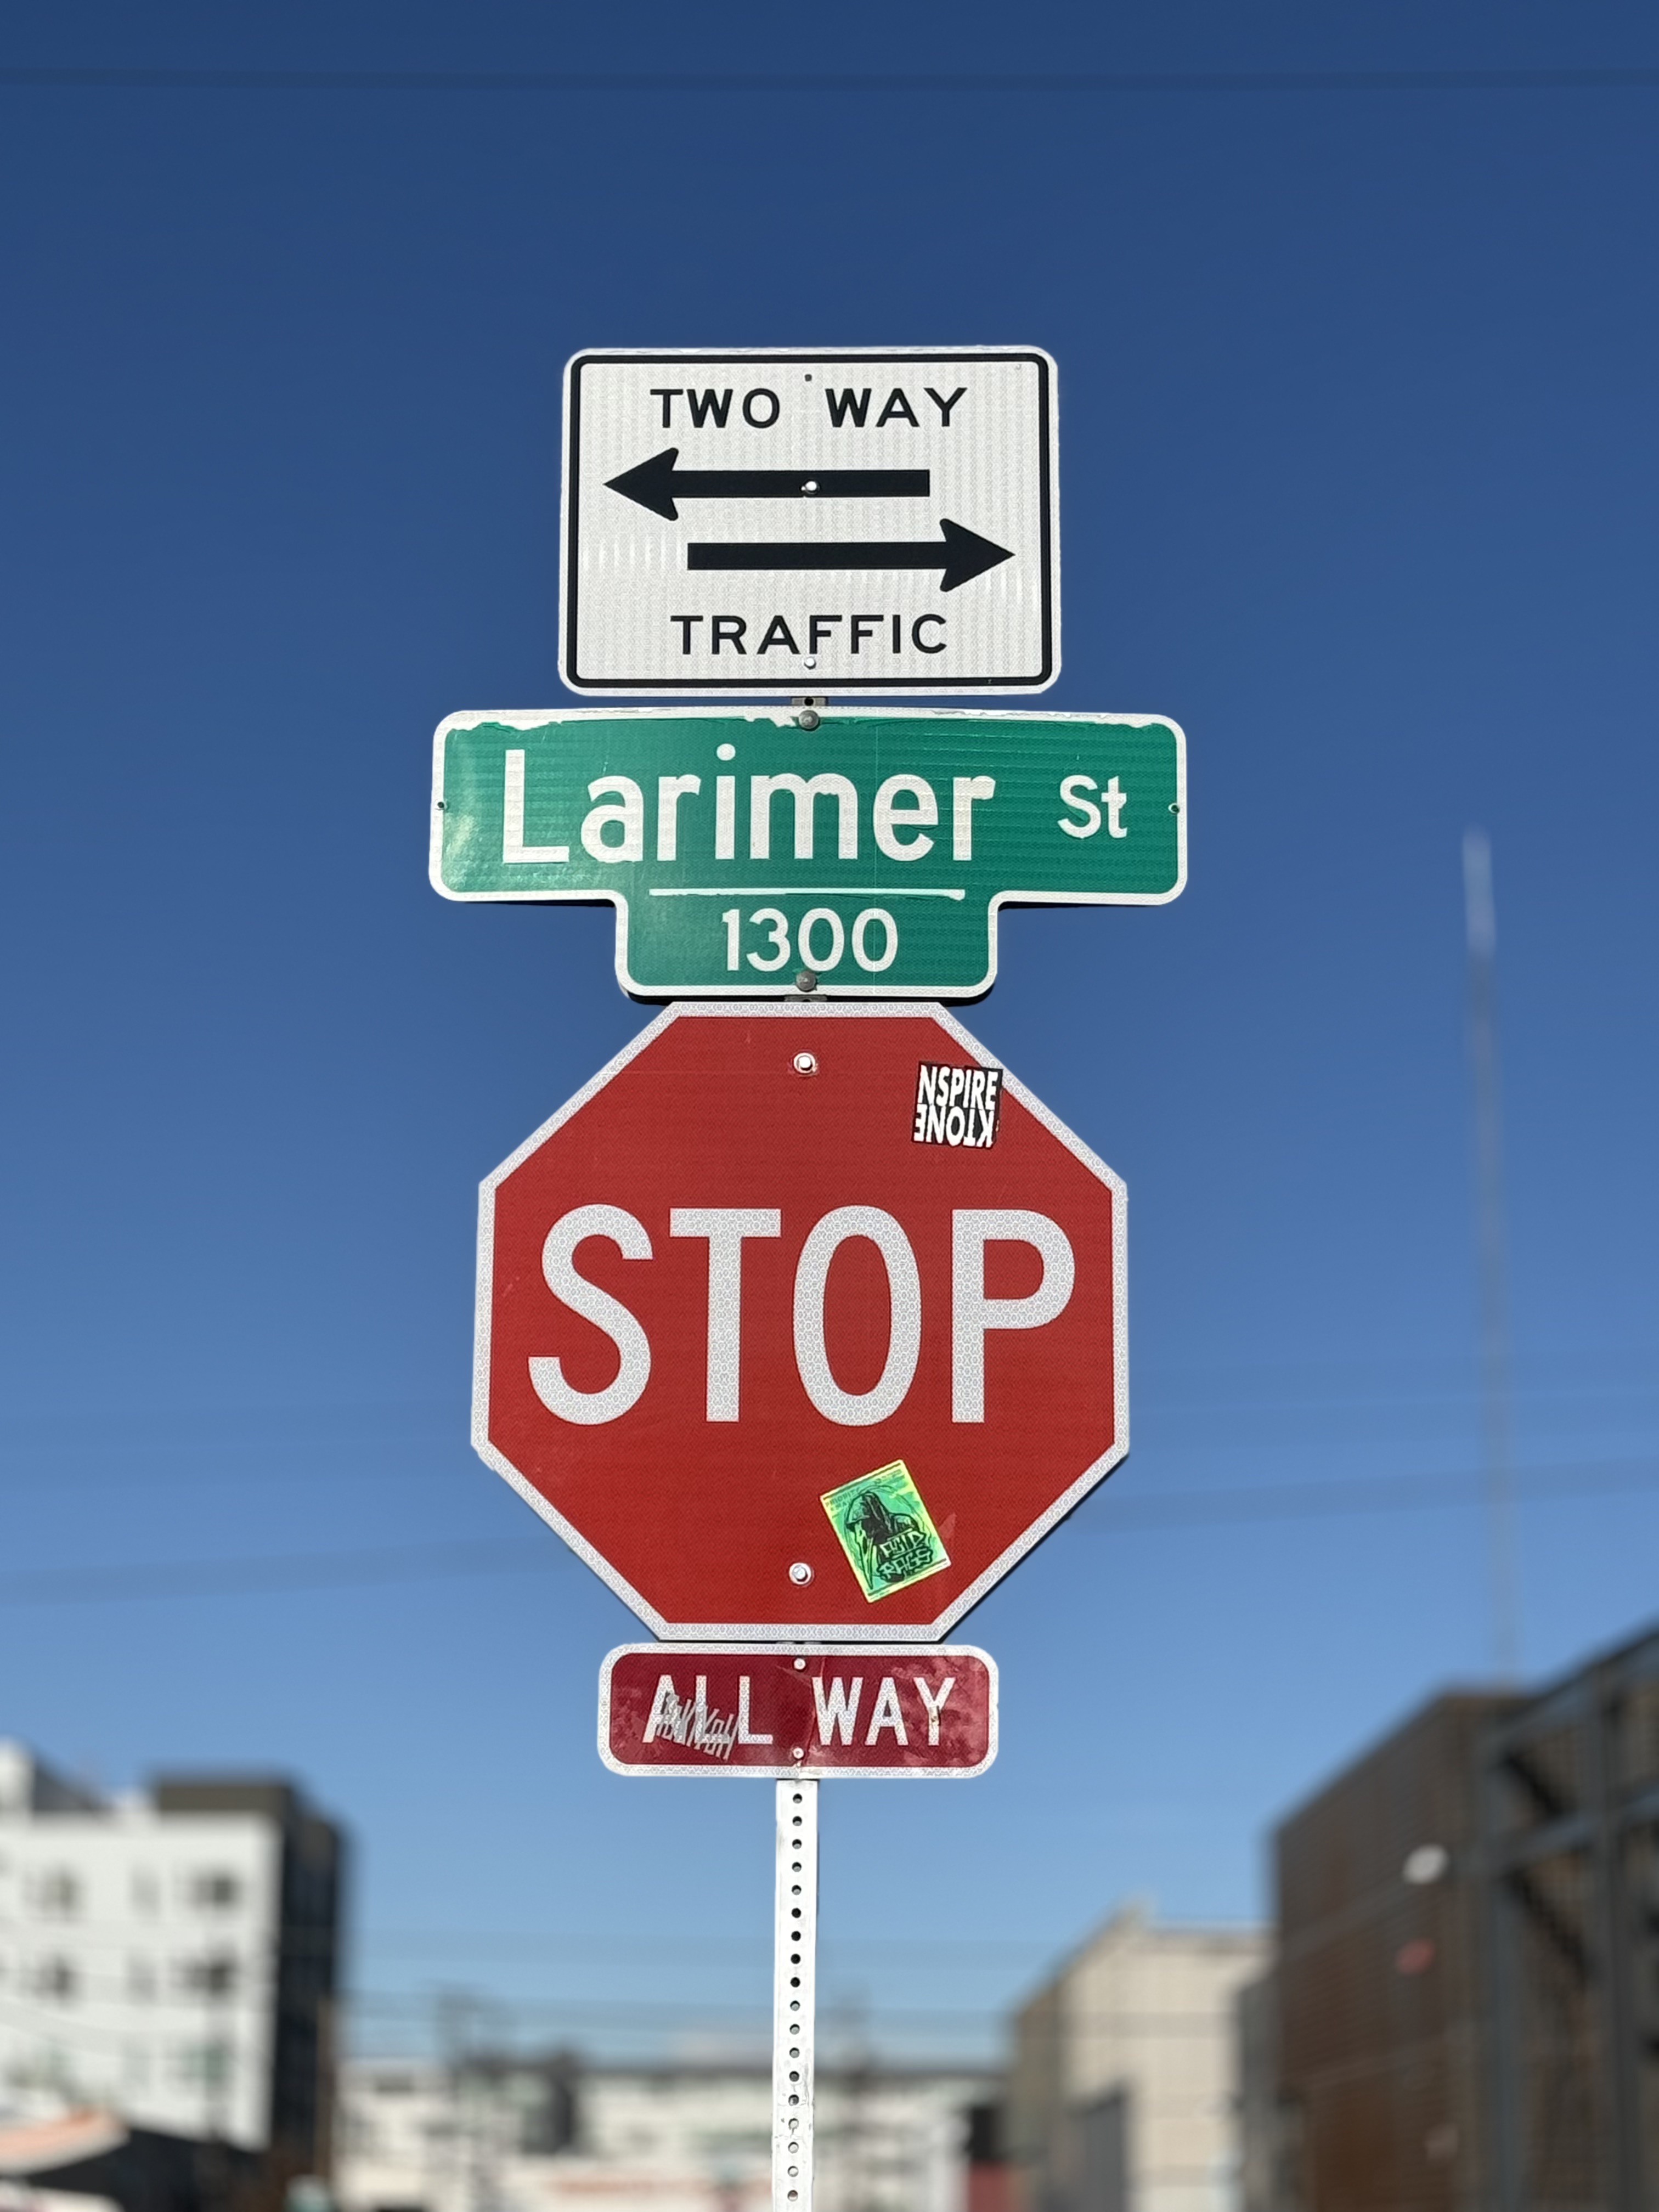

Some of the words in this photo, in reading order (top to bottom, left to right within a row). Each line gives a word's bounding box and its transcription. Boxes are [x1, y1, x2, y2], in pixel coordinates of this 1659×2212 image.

[650, 388, 780, 428] TWO
[825, 387, 967, 428] WAY
[670, 613, 947, 655] TRAFFIC
[501, 743, 996, 865] Larimer
[1057, 775, 1128, 839] St
[721, 908, 898, 972] 1300
[917, 1065, 998, 1110] NSPIRE
[528, 1204, 1075, 1426] STOP
[642, 1674, 773, 1745] ALL
[812, 1676, 956, 1746] WAY
